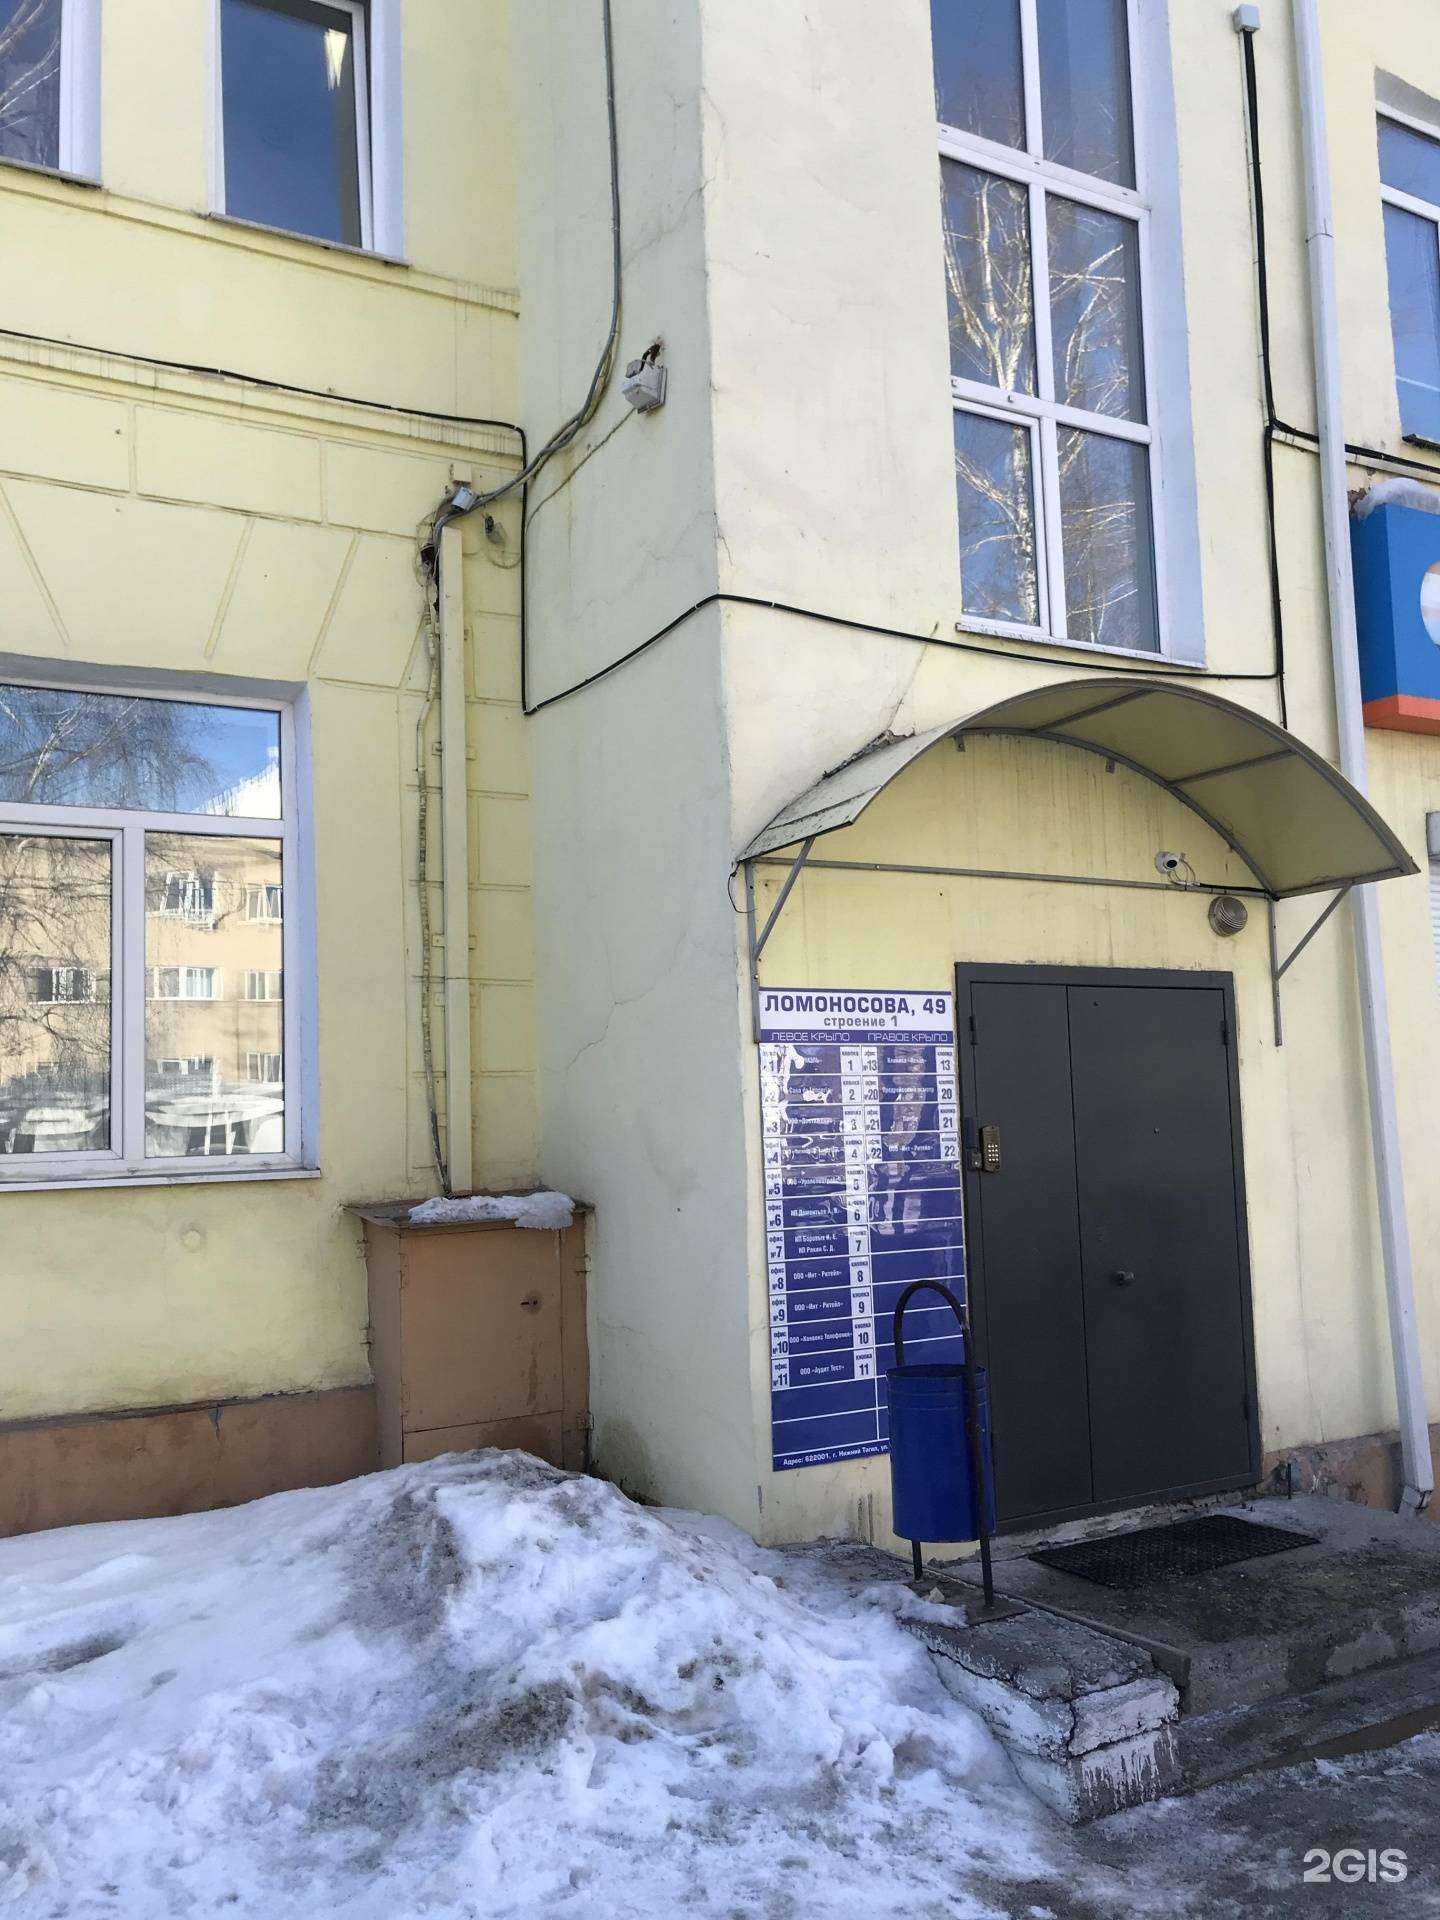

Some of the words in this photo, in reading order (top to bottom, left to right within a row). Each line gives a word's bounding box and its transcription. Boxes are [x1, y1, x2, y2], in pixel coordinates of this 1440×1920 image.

[765, 995, 915, 1016] ЛОМОНОСОВА,
[923, 998, 946, 1014] 49
[824, 1016, 885, 1029] строение
[890, 1016, 898, 1027] 1
[771, 1032, 808, 1042] ЛЕВОЕ
[810, 1033, 850, 1042] КРЫЛО
[867, 1033, 910, 1042] ПРАВОЕ
[911, 1033, 948, 1042] КРЫЛО
[941, 1060, 951, 1071] 13
[849, 1089, 855, 1100] 2
[942, 1089, 952, 1100] 20
[943, 1117, 953, 1128] 21
[851, 1149, 857, 1158] 4
[945, 1146, 955, 1157] 22
[769, 1183, 780, 1195] №5
[770, 1214, 781, 1226] №6
[854, 1209, 860, 1221] 6
[856, 1240, 861, 1251] 7
[771, 1246, 782, 1258] №7
[857, 1270, 863, 1282] 8
[772, 1277, 784, 1289] №8
[858, 1301, 865, 1313] 9
[773, 1309, 785, 1321] №9
[858, 1332, 869, 1344] 10
[773, 1341, 788, 1354] №10
[859, 1363, 869, 1375] 11
[773, 1374, 787, 1386] №11
[783, 1457, 803, 1466] Адрес:
